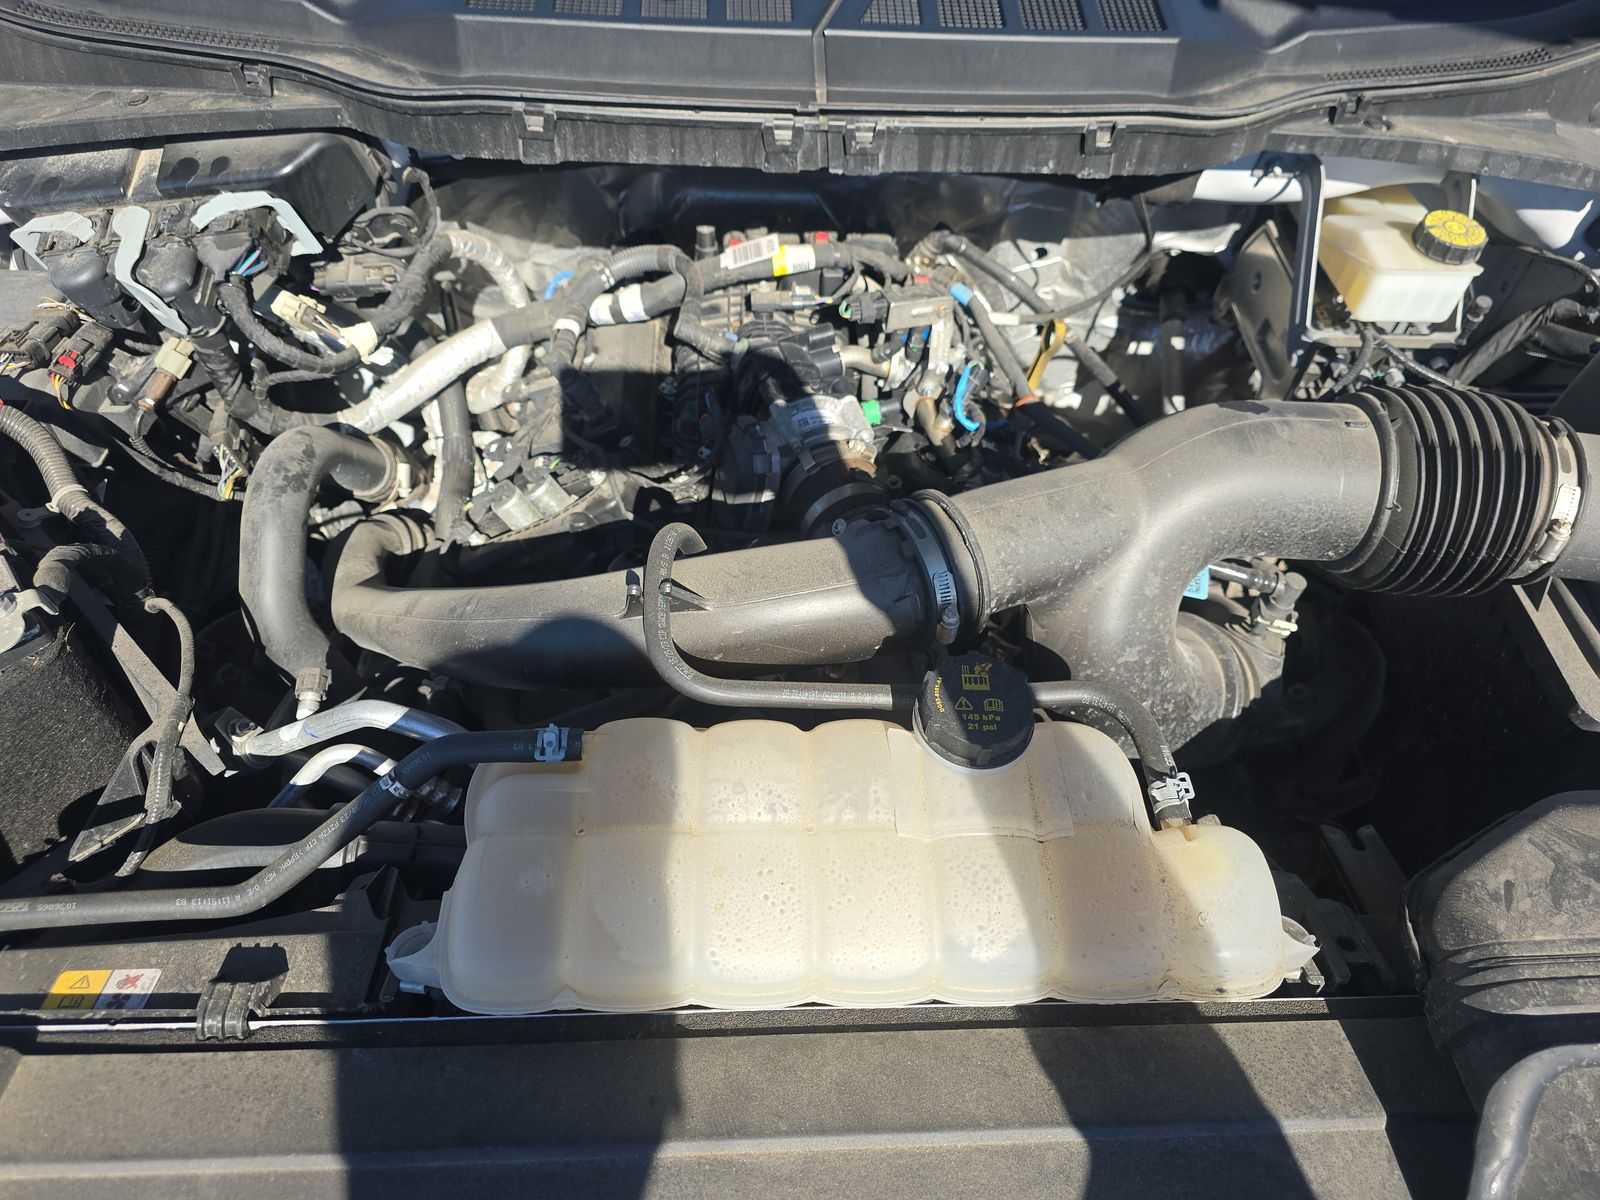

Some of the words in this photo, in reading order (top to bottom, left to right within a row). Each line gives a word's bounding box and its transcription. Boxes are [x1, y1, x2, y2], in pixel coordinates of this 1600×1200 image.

[659, 631, 667, 640] CIP
[982, 723, 998, 732] psi
[305, 838, 318, 851] CIP
[175, 897, 187, 906] B3
